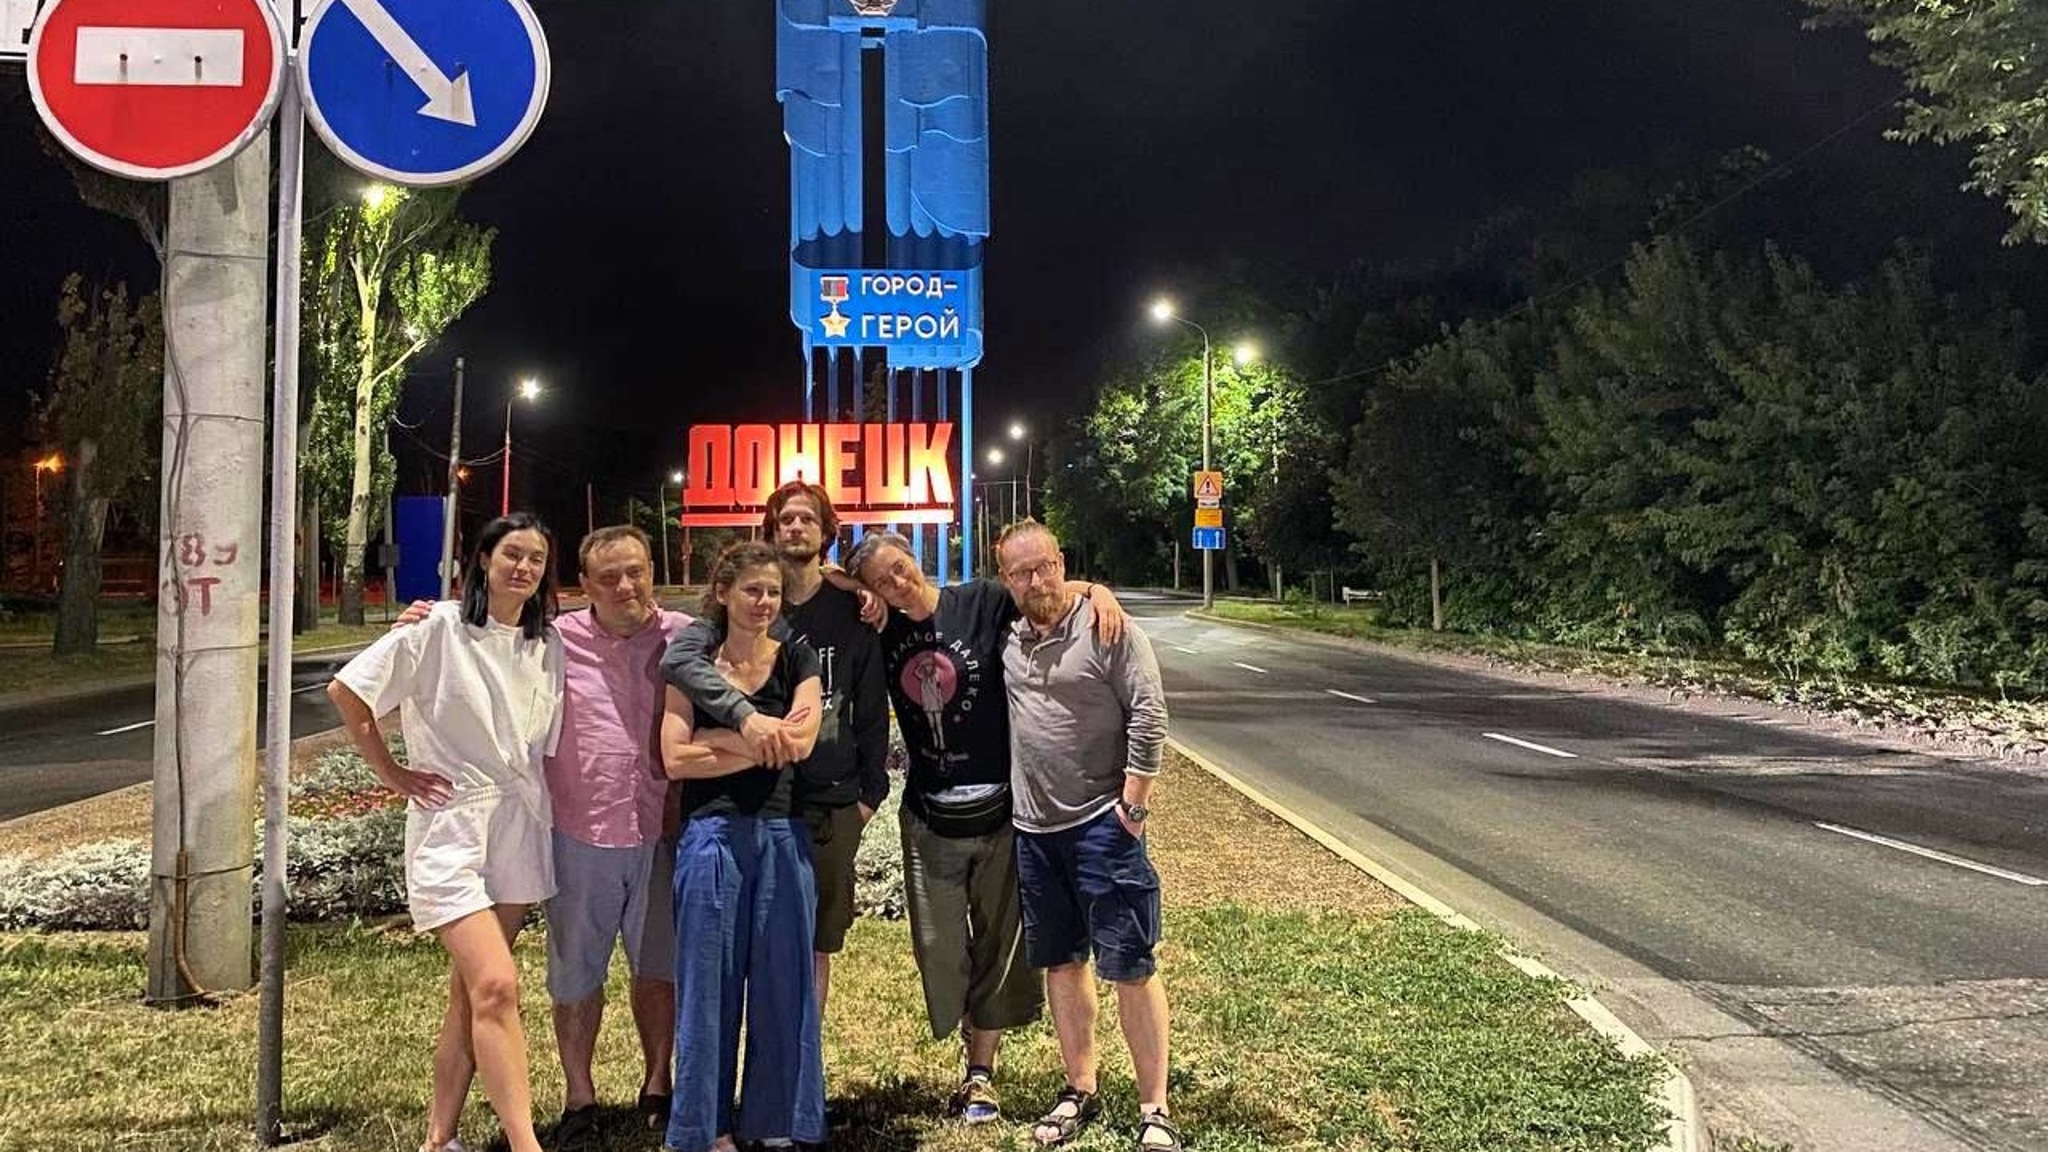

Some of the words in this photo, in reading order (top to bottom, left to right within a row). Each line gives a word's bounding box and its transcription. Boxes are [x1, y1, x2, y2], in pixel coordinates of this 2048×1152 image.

[861, 276, 957, 299] ГОРОД-
[861, 308, 959, 338] ГЕРОЙ
[683, 423, 954, 505] ДОНЕЦК
